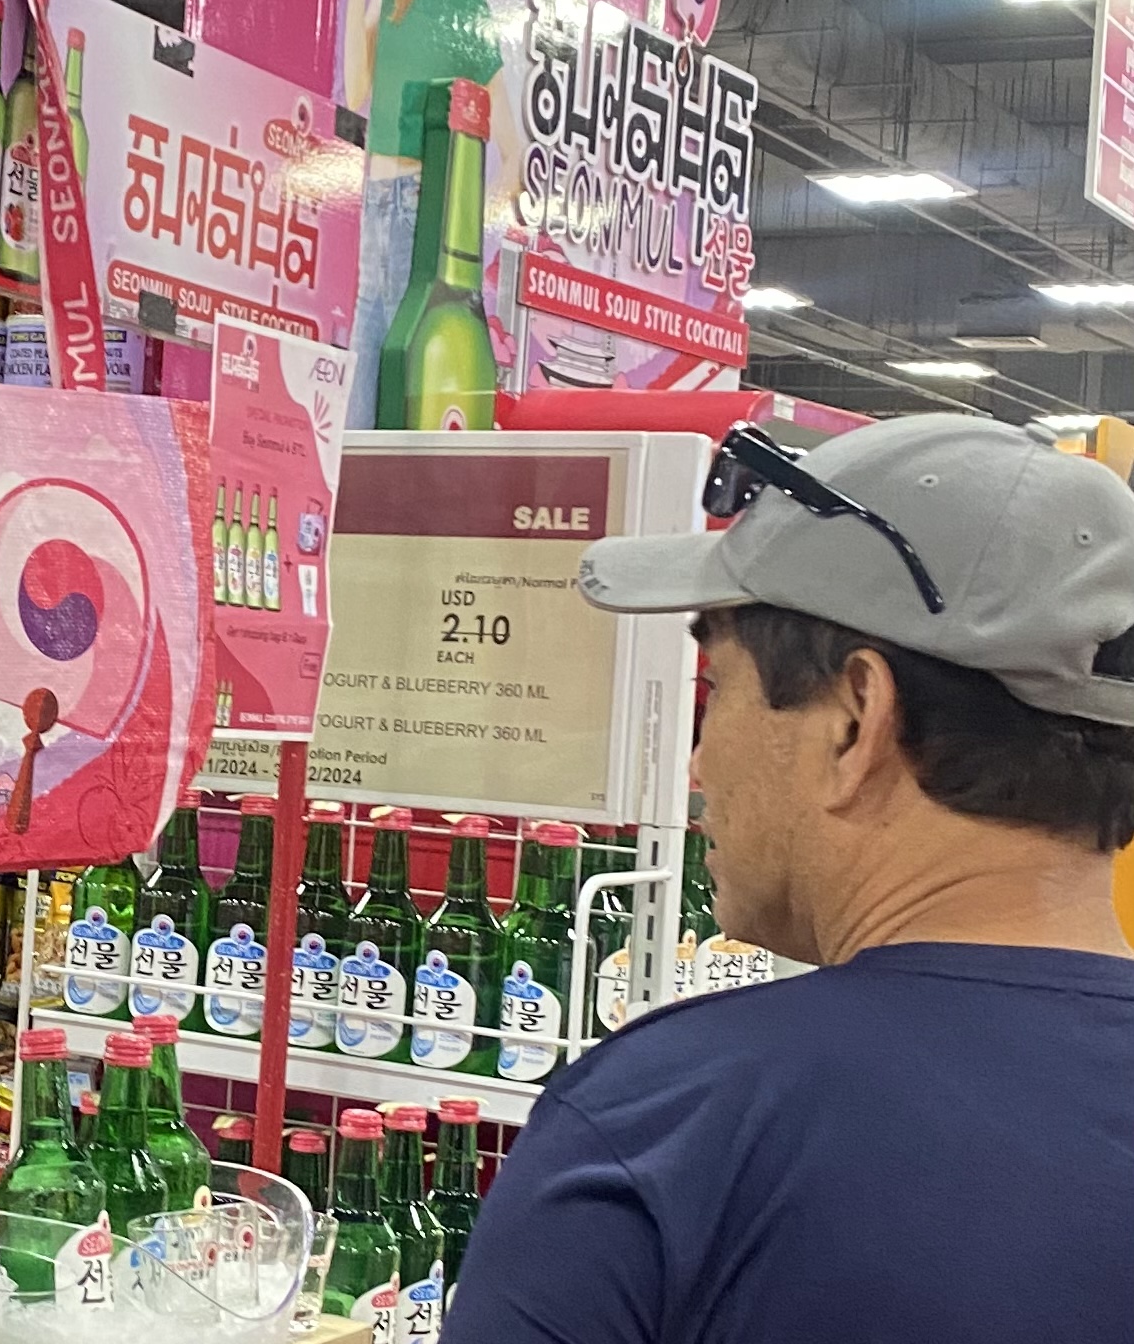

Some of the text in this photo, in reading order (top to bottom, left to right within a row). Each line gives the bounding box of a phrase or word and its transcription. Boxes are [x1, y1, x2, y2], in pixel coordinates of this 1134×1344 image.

[177, 289, 213, 315] SOJU
[527, 266, 744, 357] SEONMUL SOJU STYLE COCKTAIL
[513, 505, 591, 532] SALE
[441, 589, 476, 607] USD
[441, 612, 511, 645] 2.10
[437, 650, 475, 665] EACH
[323, 673, 550, 701] OGURT & BLUEBERRY 360 ML
[318, 714, 376, 732] OGURT
[378, 717, 389, 732] &
[393, 718, 489, 739] BLUEBERRY
[492, 723, 521, 741] 360
[524, 726, 548, 744] ML
[309, 748, 388, 765] otion Period
[308, 766, 363, 785] 2/2024
